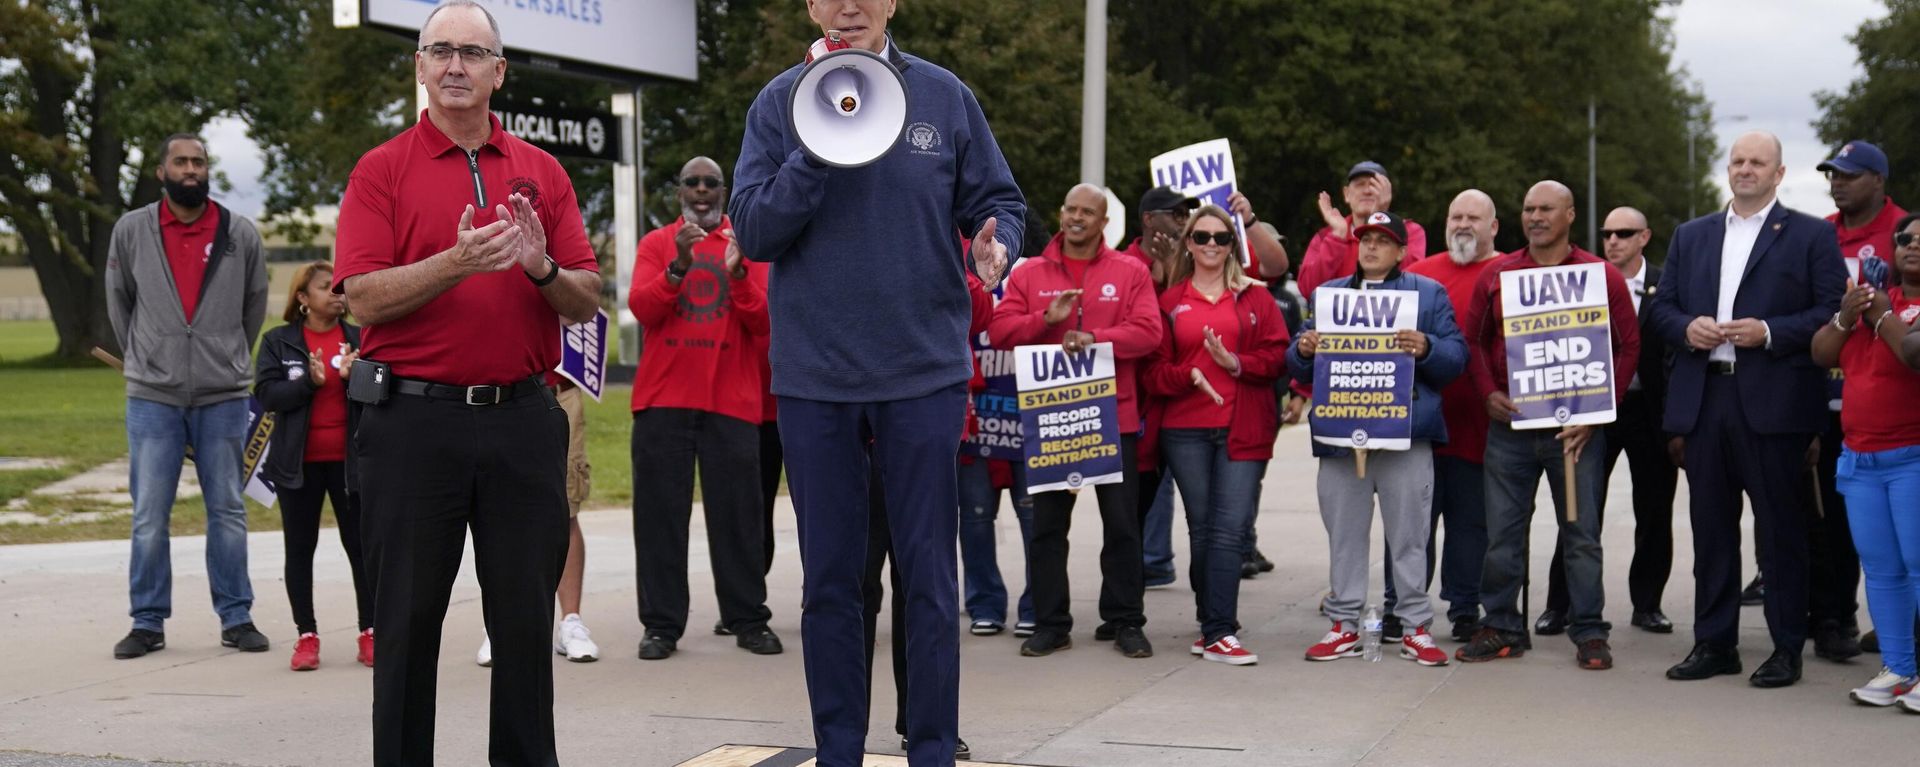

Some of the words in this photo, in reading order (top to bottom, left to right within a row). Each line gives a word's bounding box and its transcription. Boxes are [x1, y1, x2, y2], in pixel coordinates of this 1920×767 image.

[505, 112, 558, 142] LOCAL
[558, 119, 583, 145] 174
[1157, 152, 1224, 189] UAW
[1518, 270, 1588, 307] UAW
[1332, 293, 1402, 328] UAW
[1511, 314, 1570, 332] STAND
[1577, 311, 1602, 323] UP
[584, 314, 599, 392] STRIK
[1320, 338, 1379, 350] STAND
[1386, 338, 1401, 350] U
[1524, 336, 1591, 367] END
[1032, 348, 1097, 382] UAW
[1330, 361, 1396, 375] RECORD
[1330, 375, 1396, 388] PROFITS
[1513, 361, 1607, 395] TIERS
[1025, 388, 1082, 406] STAND
[1088, 383, 1110, 396] UP
[1329, 392, 1394, 404] RECORD
[1038, 406, 1101, 426] RECORD
[1315, 405, 1408, 419] CONTRACTS
[1039, 419, 1102, 439] PROFITS
[1040, 433, 1103, 454] RECORD
[1028, 444, 1118, 468] CONTRACTS
